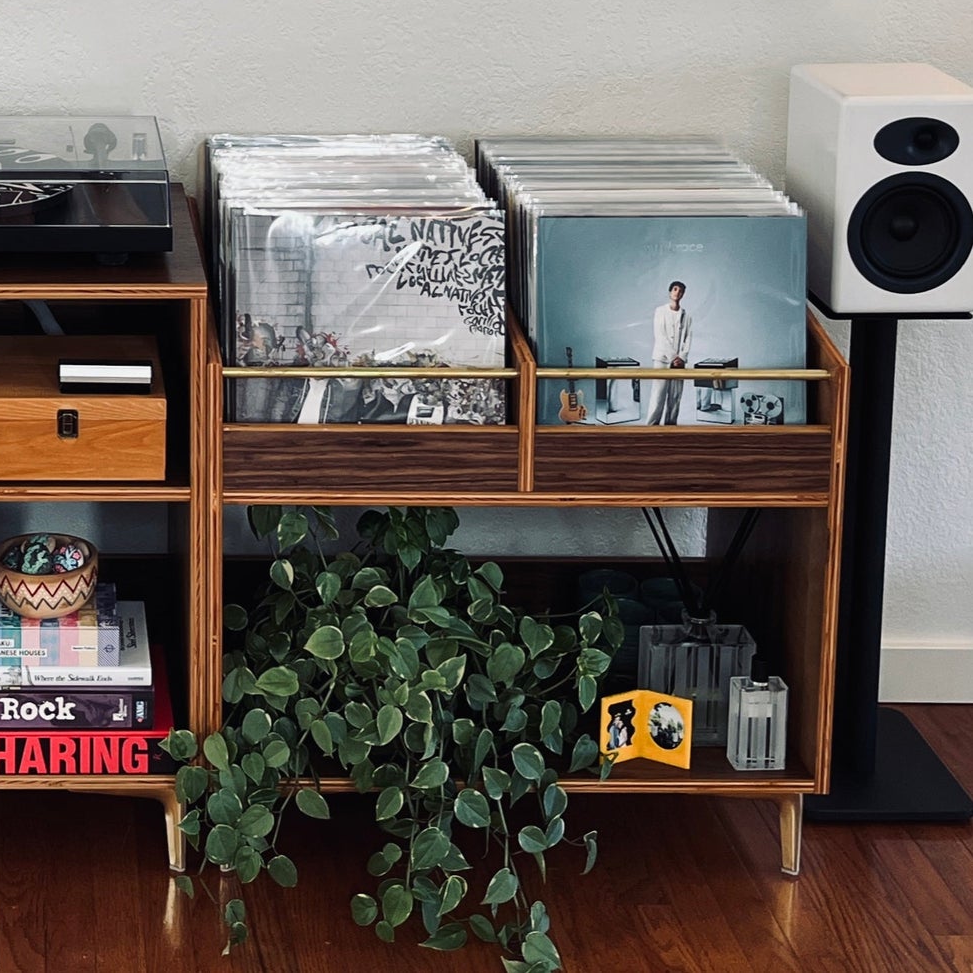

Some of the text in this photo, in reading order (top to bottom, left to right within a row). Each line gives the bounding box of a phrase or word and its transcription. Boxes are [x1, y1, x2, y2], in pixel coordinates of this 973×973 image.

[34, 673, 55, 682] Where
[55, 674, 66, 682] the
[67, 673, 95, 682] Sidewalk
[96, 674, 113, 682] Ends
